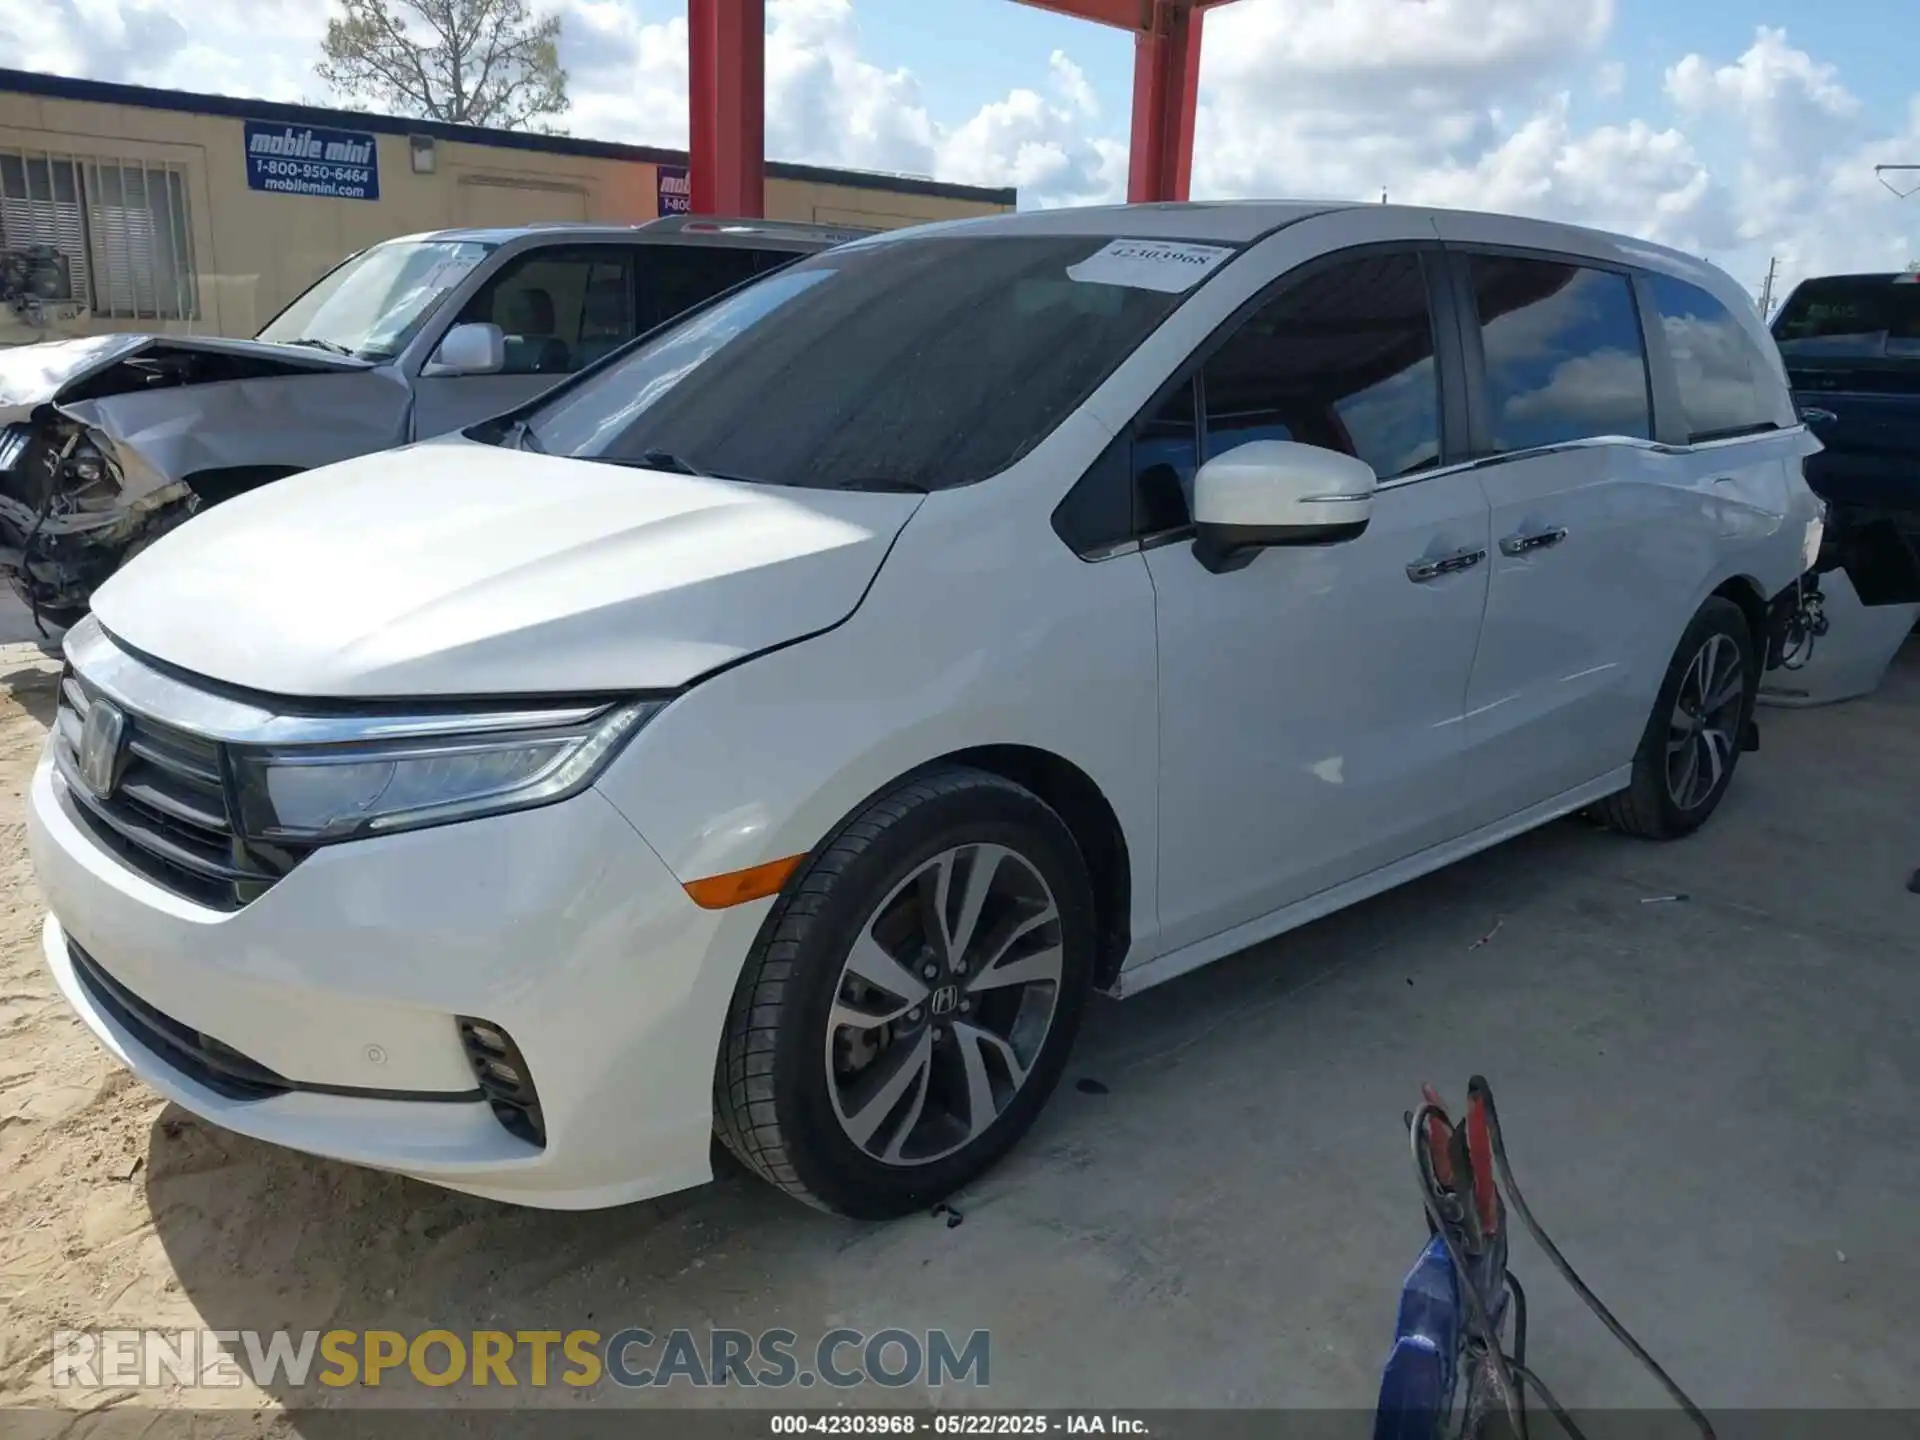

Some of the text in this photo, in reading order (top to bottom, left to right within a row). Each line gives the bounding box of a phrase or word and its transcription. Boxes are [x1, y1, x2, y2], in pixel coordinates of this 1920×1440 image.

[250, 128, 374, 163] mobile mini
[256, 160, 369, 182] 1-800-950-6464
[264, 178, 365, 197] mobilemini.com
